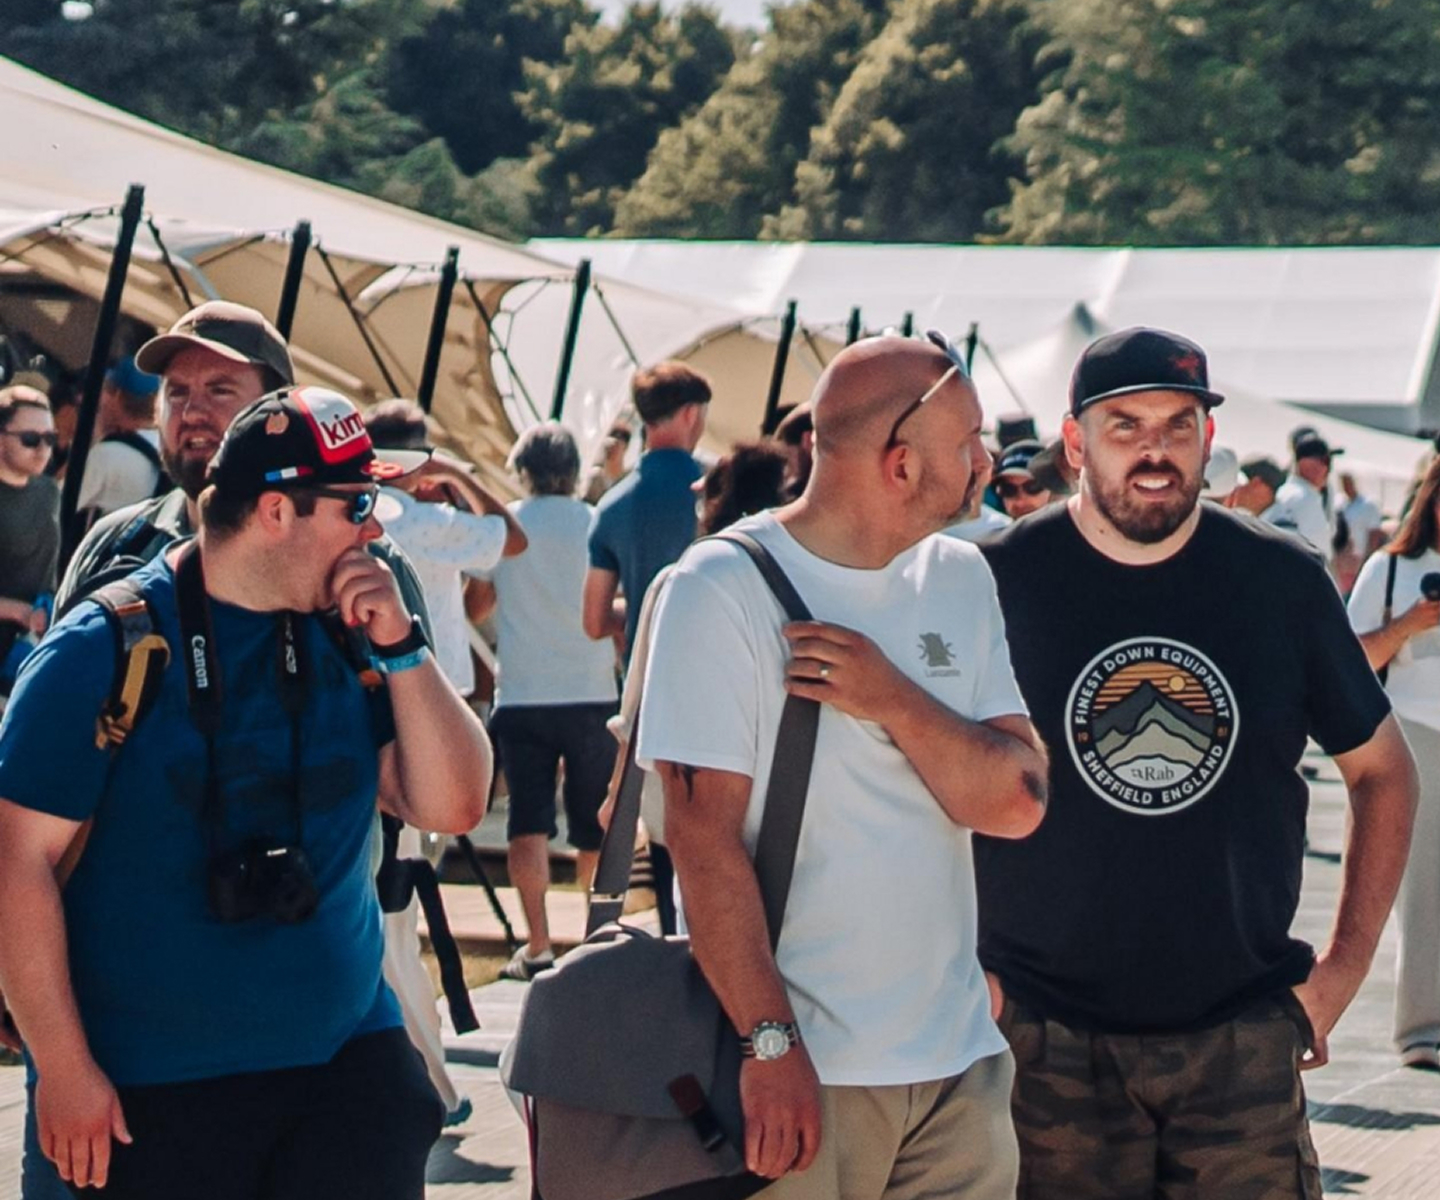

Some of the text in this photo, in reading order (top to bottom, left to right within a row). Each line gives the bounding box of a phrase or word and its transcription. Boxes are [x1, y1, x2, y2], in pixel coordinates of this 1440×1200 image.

[191, 634, 209, 689] Canon
[1075, 646, 1230, 725] FINEST DOWN EQUIPMENT
[1083, 744, 1223, 805] SHEFFIELD ENGLAND
[1145, 765, 1175, 782] Rab
